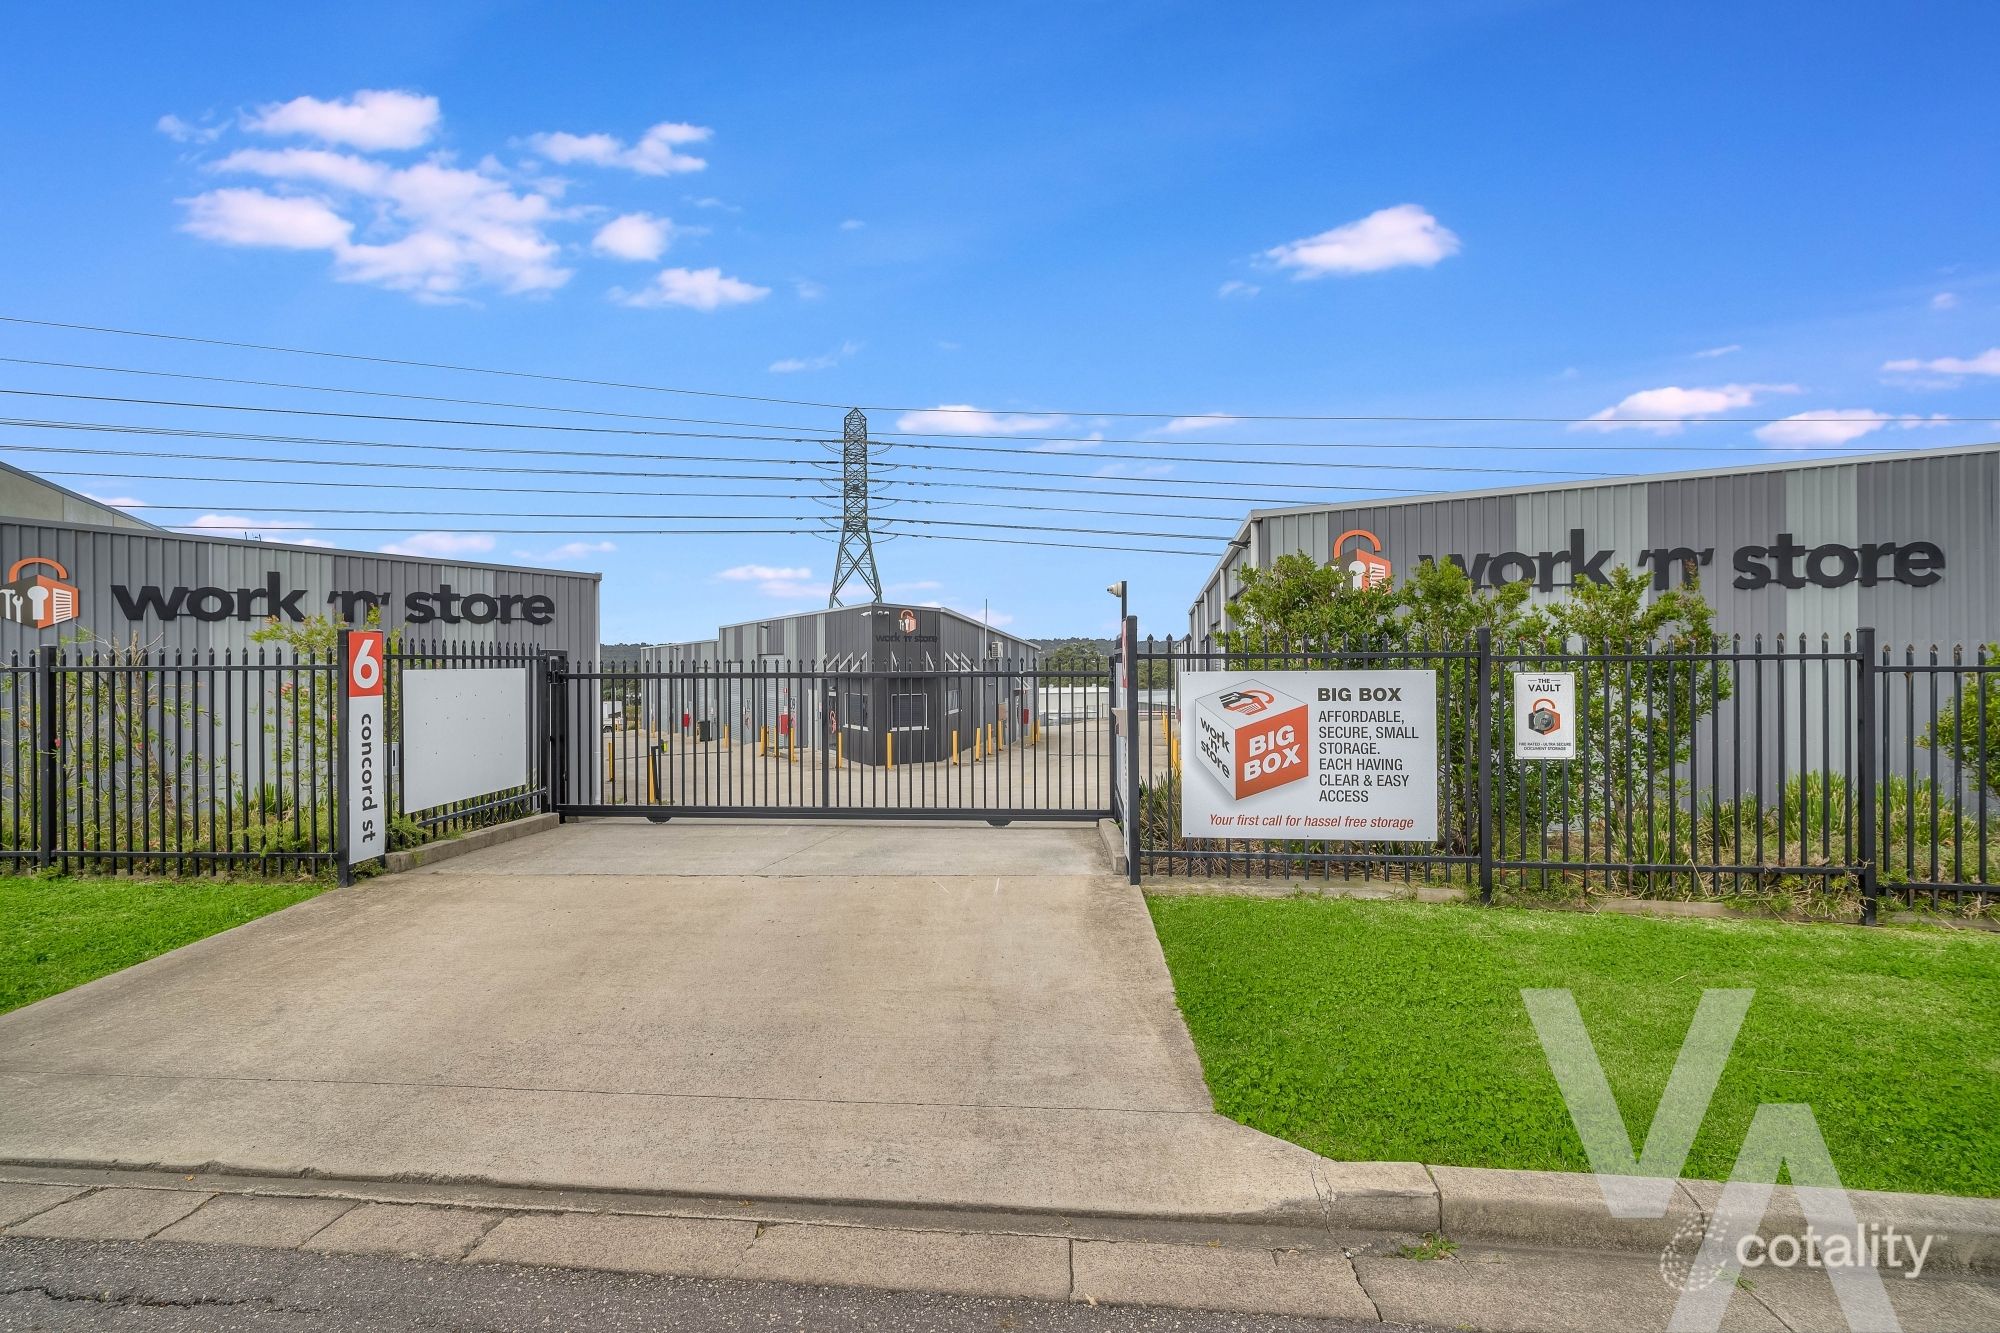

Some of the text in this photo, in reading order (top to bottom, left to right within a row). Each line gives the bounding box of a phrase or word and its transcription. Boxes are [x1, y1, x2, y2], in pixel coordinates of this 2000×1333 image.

[1733, 533, 1946, 589] store
[110, 571, 308, 622] work
[404, 584, 556, 626] store
[352, 639, 380, 689] 6
[1317, 687, 1402, 702] BIG BOX
[1528, 684, 1561, 692] VAULT
[1318, 710, 1405, 725] AFFORDABLE,
[1200, 717, 1230, 754] work
[1249, 725, 1295, 757] BIG
[1318, 726, 1419, 741] SECURE, SMALL
[1318, 742, 1380, 755] STORAGE.
[1201, 740, 1230, 779] store
[1244, 743, 1302, 781] BOX
[1319, 758, 1403, 771] EACH HAVING
[361, 713, 378, 843] concord st
[1319, 774, 1409, 787] CLEAR & EASY
[1318, 789, 1369, 803] ACCESS
[1209, 814, 1414, 830] Your first call for hassel free storage
